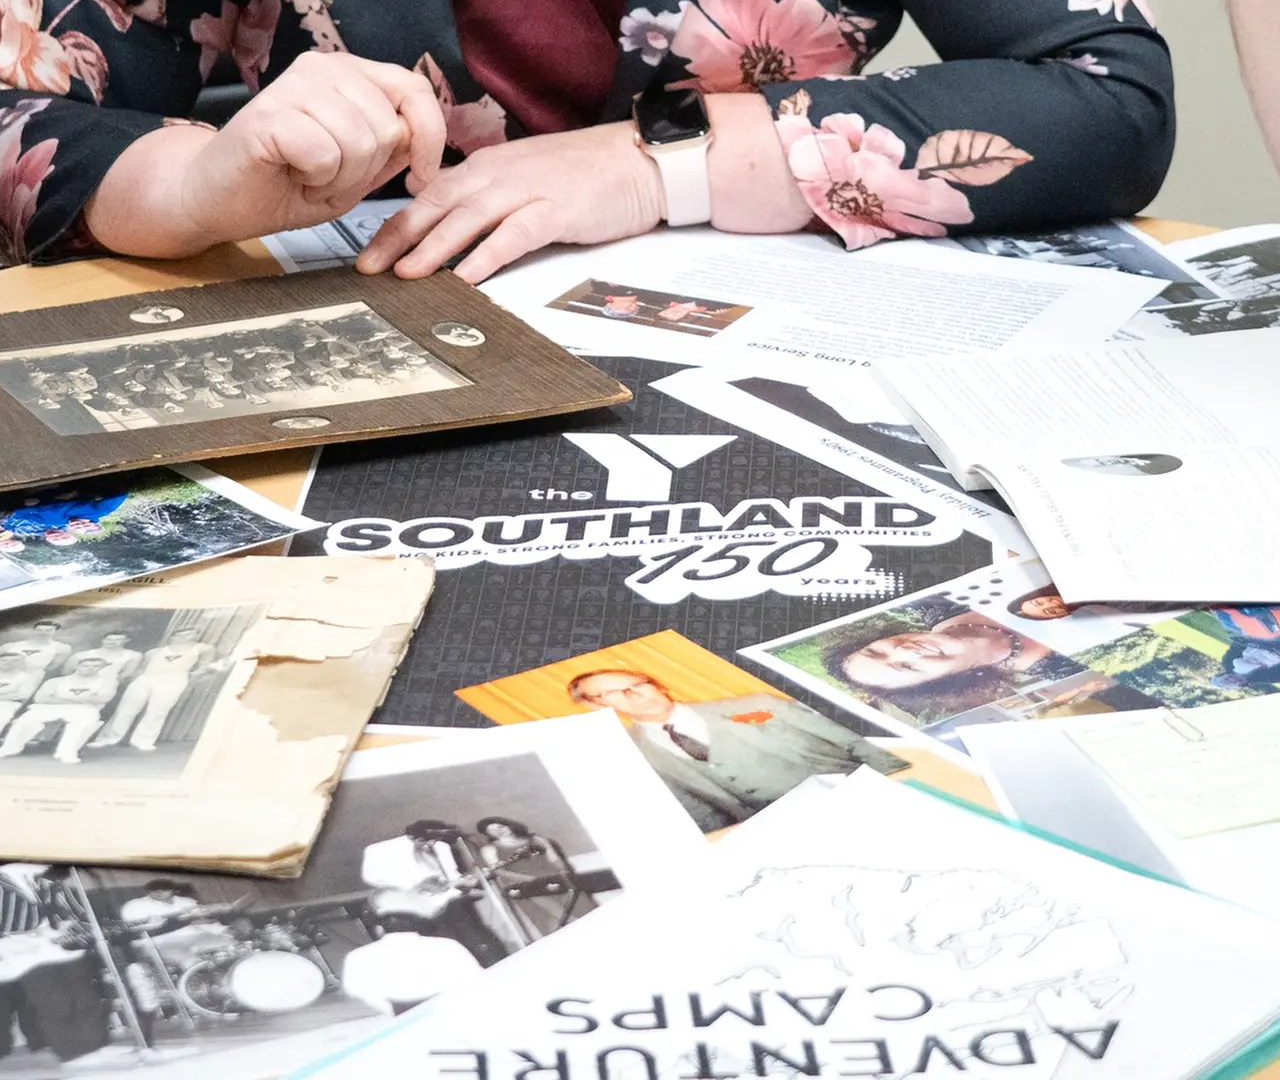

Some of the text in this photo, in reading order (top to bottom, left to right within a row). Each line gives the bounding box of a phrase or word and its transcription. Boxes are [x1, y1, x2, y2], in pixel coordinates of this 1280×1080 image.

[746, 342, 809, 358] Service
[814, 352, 856, 366] Long
[860, 454, 935, 493] Programmes
[528, 487, 594, 501] the
[938, 490, 992, 518] Holiday
[336, 501, 937, 552] SOUTHLAND
[435, 548, 489, 558] KIDS,
[497, 543, 584, 554] STRONG
[588, 535, 687, 549] FAMILIES,
[693, 531, 776, 542] STRONG
[784, 528, 933, 538] COMMUNITIES
[635, 536, 839, 585] 150
[800, 576, 877, 587] years
[546, 983, 933, 1034] CAMPS
[429, 1019, 1121, 1080] ADVENTURE
